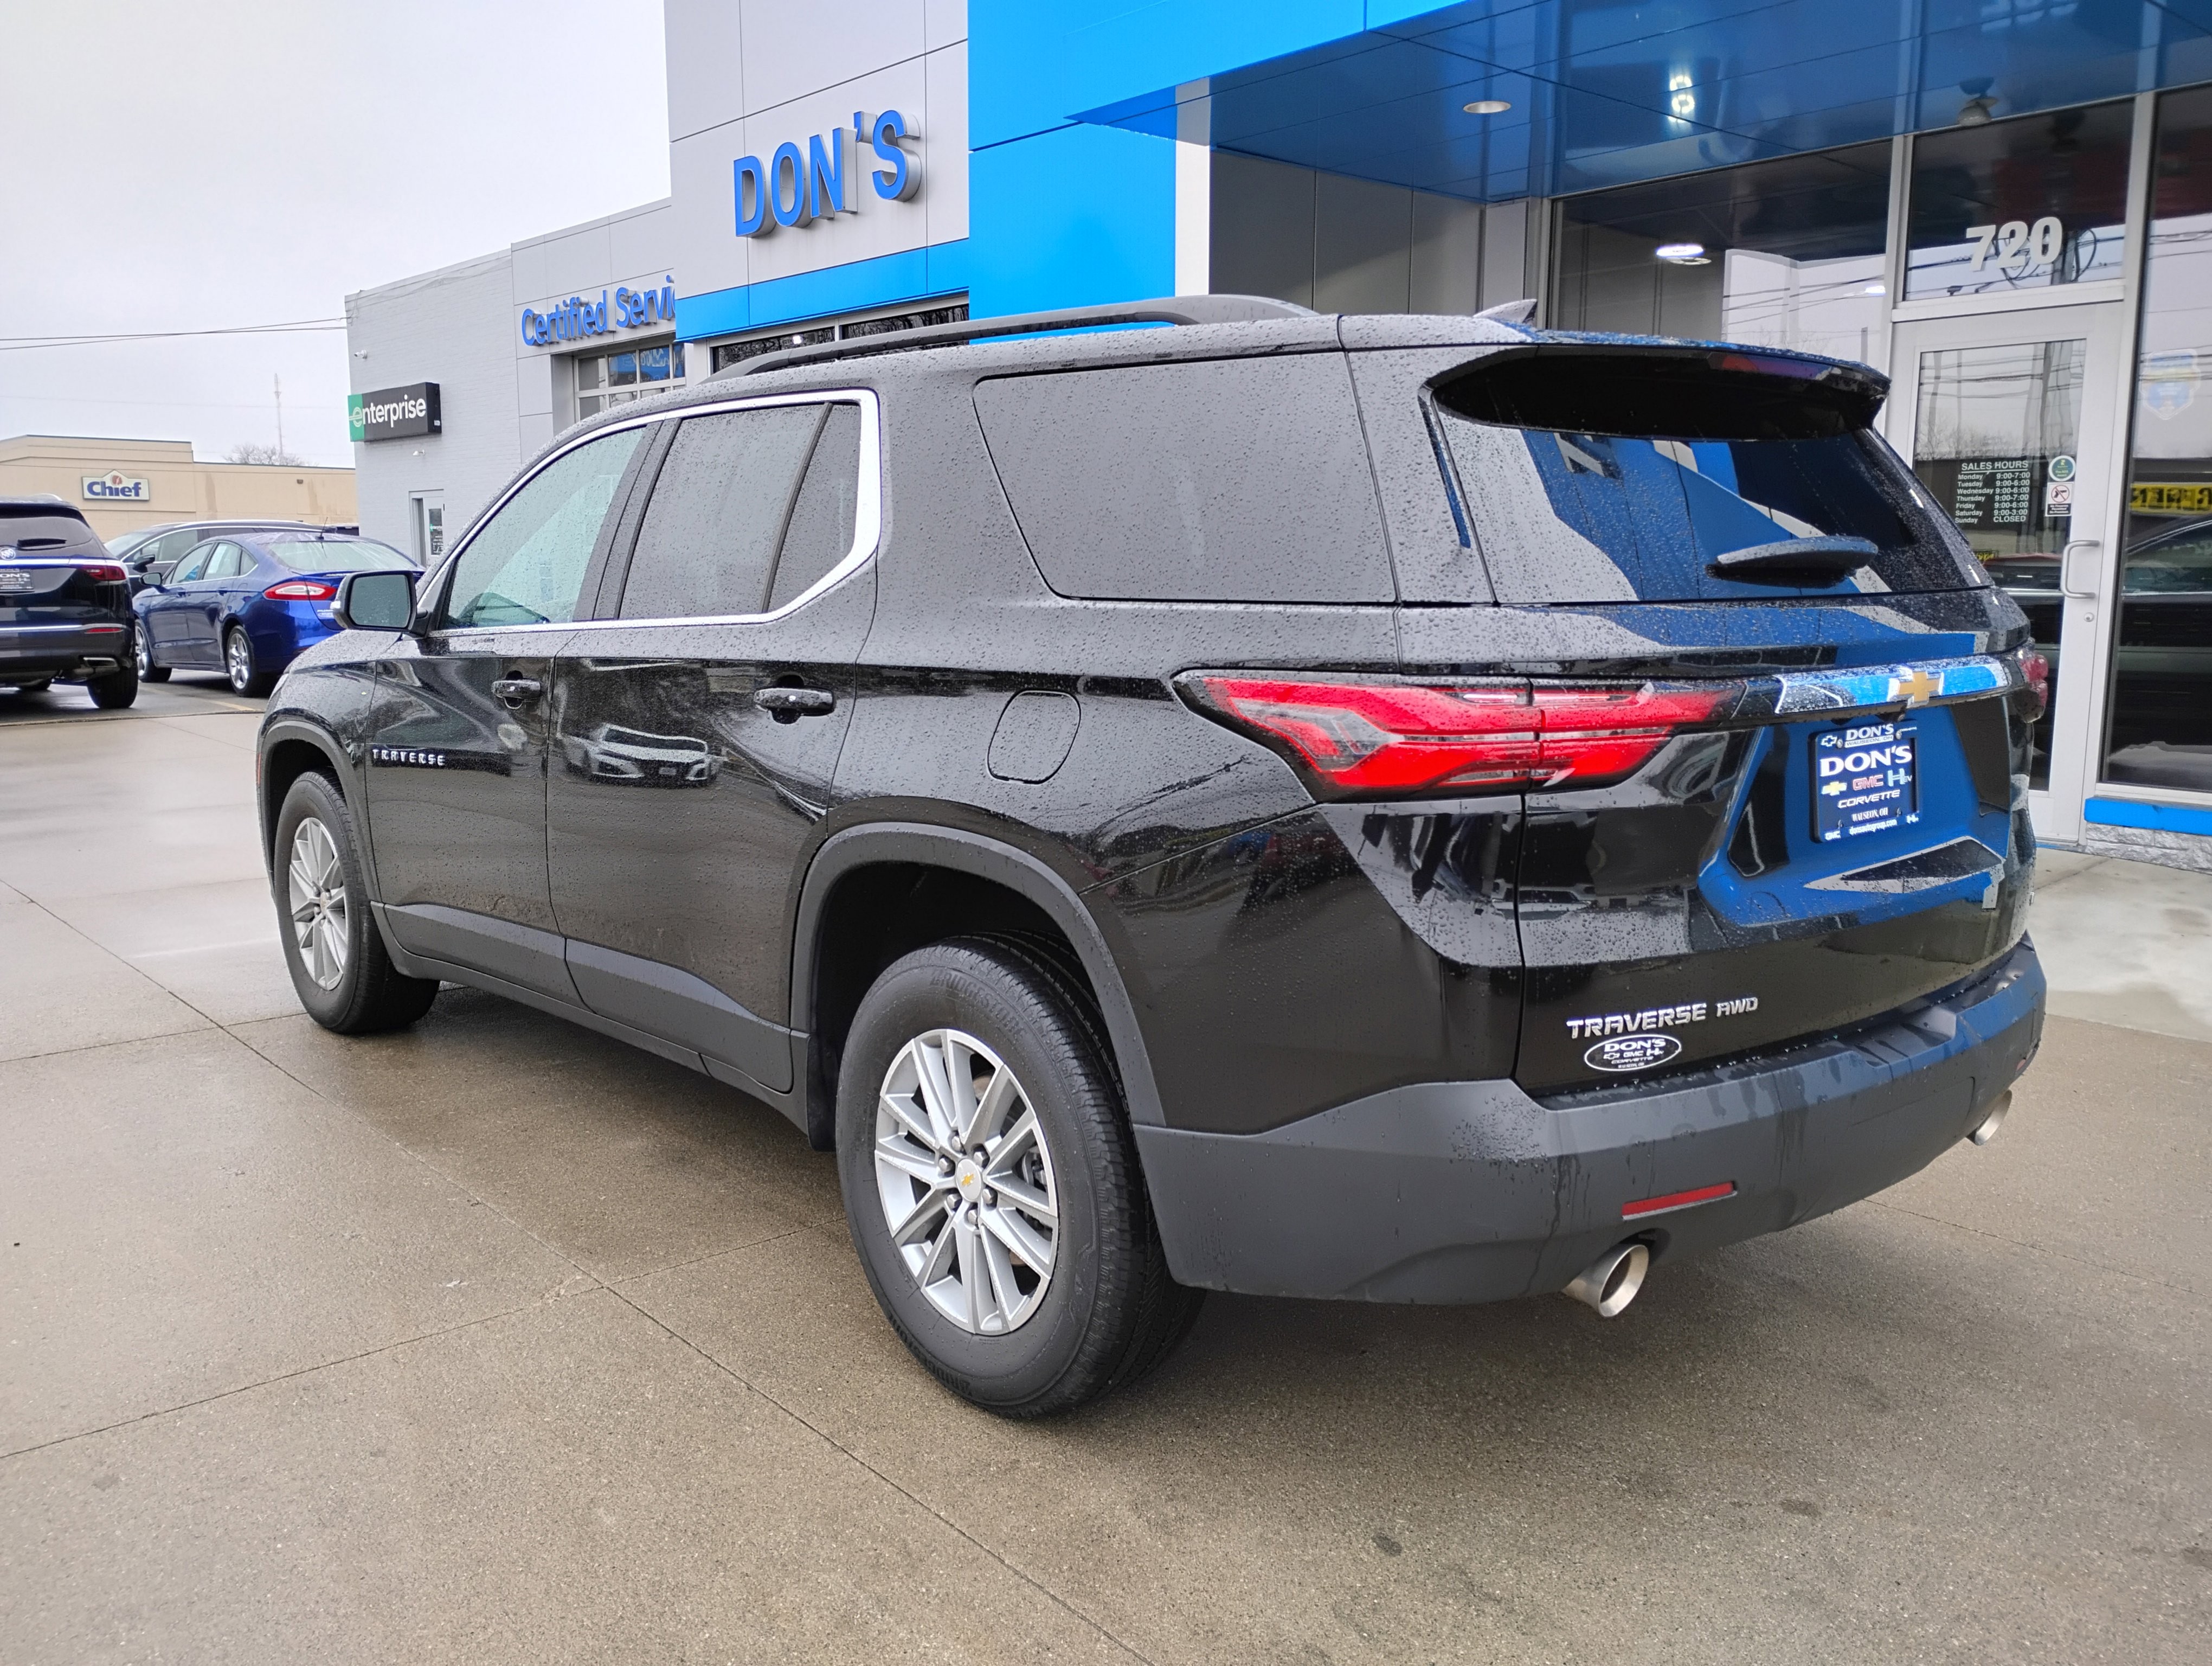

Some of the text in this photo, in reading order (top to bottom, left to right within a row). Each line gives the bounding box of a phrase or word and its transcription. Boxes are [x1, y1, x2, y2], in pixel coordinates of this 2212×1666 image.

[734, 110, 916, 237] DON'S
[1966, 217, 2063, 272] 720
[522, 274, 676, 346] Certified Servi
[349, 394, 427, 428] enterprise
[1962, 460, 2029, 470] SALES HOURS
[87, 481, 142, 497] Chief
[1846, 723, 1894, 741] DON'S
[372, 749, 446, 766] TRAVERSE
[1820, 745, 1912, 777] DON'S
[1853, 774, 1884, 791] GMC
[1837, 789, 1900, 809] CORVETTE
[1824, 831, 1841, 841] GMC
[1566, 997, 1758, 1039] TRAVERSE AWD
[1604, 1039, 1666, 1052] DON'S
[1611, 1055, 1654, 1065] CORVETTE
